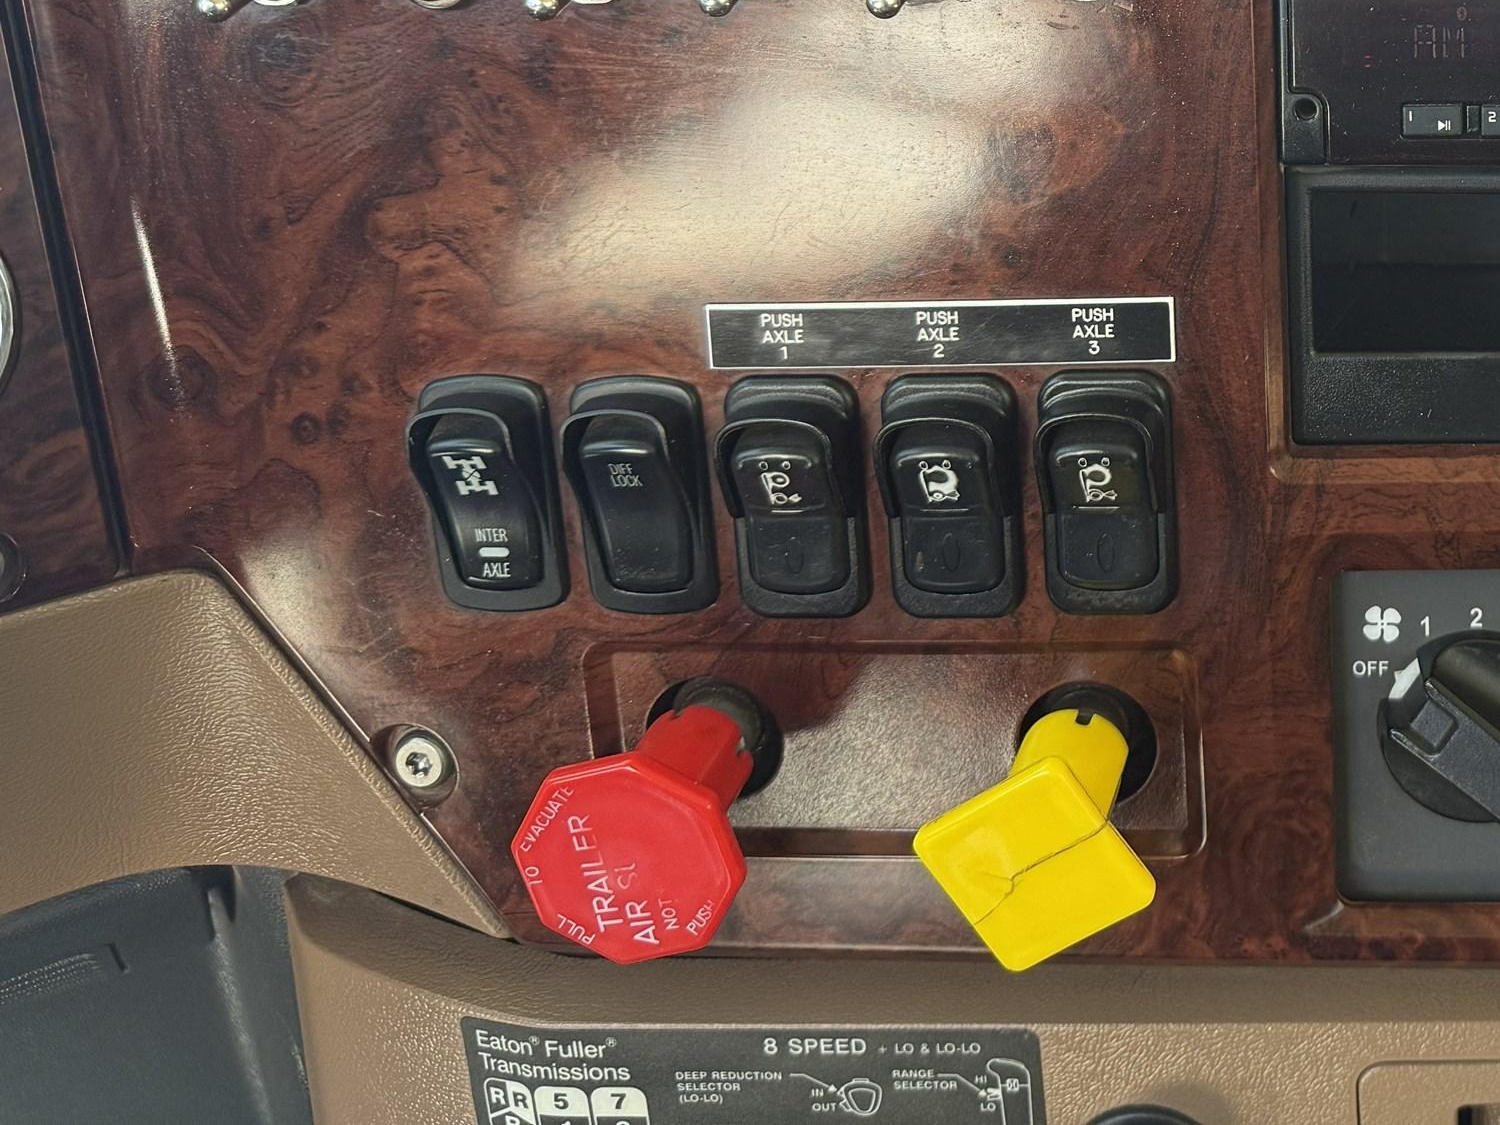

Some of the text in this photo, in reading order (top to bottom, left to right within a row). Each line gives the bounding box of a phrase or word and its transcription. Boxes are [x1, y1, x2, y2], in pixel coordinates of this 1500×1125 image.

[1408, 110, 1413, 122] 1
[1488, 111, 1497, 122] 2
[760, 313, 803, 327] PUSH
[916, 310, 958, 325] PUSH
[1071, 308, 1114, 322] PUSH
[762, 329, 804, 344] AXLE
[917, 327, 960, 341] AXLE
[1072, 324, 1115, 338] AXLE
[780, 346, 788, 360] 1
[933, 344, 945, 358] 2
[1088, 341, 1101, 355] 3
[608, 463, 633, 475] DIFF
[611, 475, 643, 487] LOCK
[475, 528, 508, 543] INTER
[483, 562, 511, 577] AXLE
[1470, 607, 1483, 628] 2
[1420, 616, 1431, 637] 1
[1352, 660, 1389, 676] OFF
[519, 786, 575, 853] EVACUATE
[567, 814, 624, 933] TRAILER
[625, 899, 661, 945] AIR
[763, 1037, 778, 1055] 8
[788, 1037, 867, 1055] SPEED
[894, 1042, 915, 1055] LO
[920, 1043, 931, 1054] &
[936, 1042, 982, 1055] LO-LO
[478, 1051, 632, 1082] Transmissions
[675, 1071, 782, 1081] DEEP REDUCTION
[892, 1069, 935, 1079] RANGE
[975, 1074, 988, 1084] HI
[677, 1082, 741, 1092] SELECTOR
[811, 1088, 824, 1097] IN
[893, 1080, 958, 1091] SELECTOR
[489, 1086, 507, 1106] R
[512, 1091, 530, 1110] R
[553, 1092, 570, 1111] 5
[610, 1092, 628, 1111] 7
[679, 1093, 724, 1106] (LO-LO)
[812, 1102, 837, 1113] OUT
[980, 1102, 997, 1113] LO
